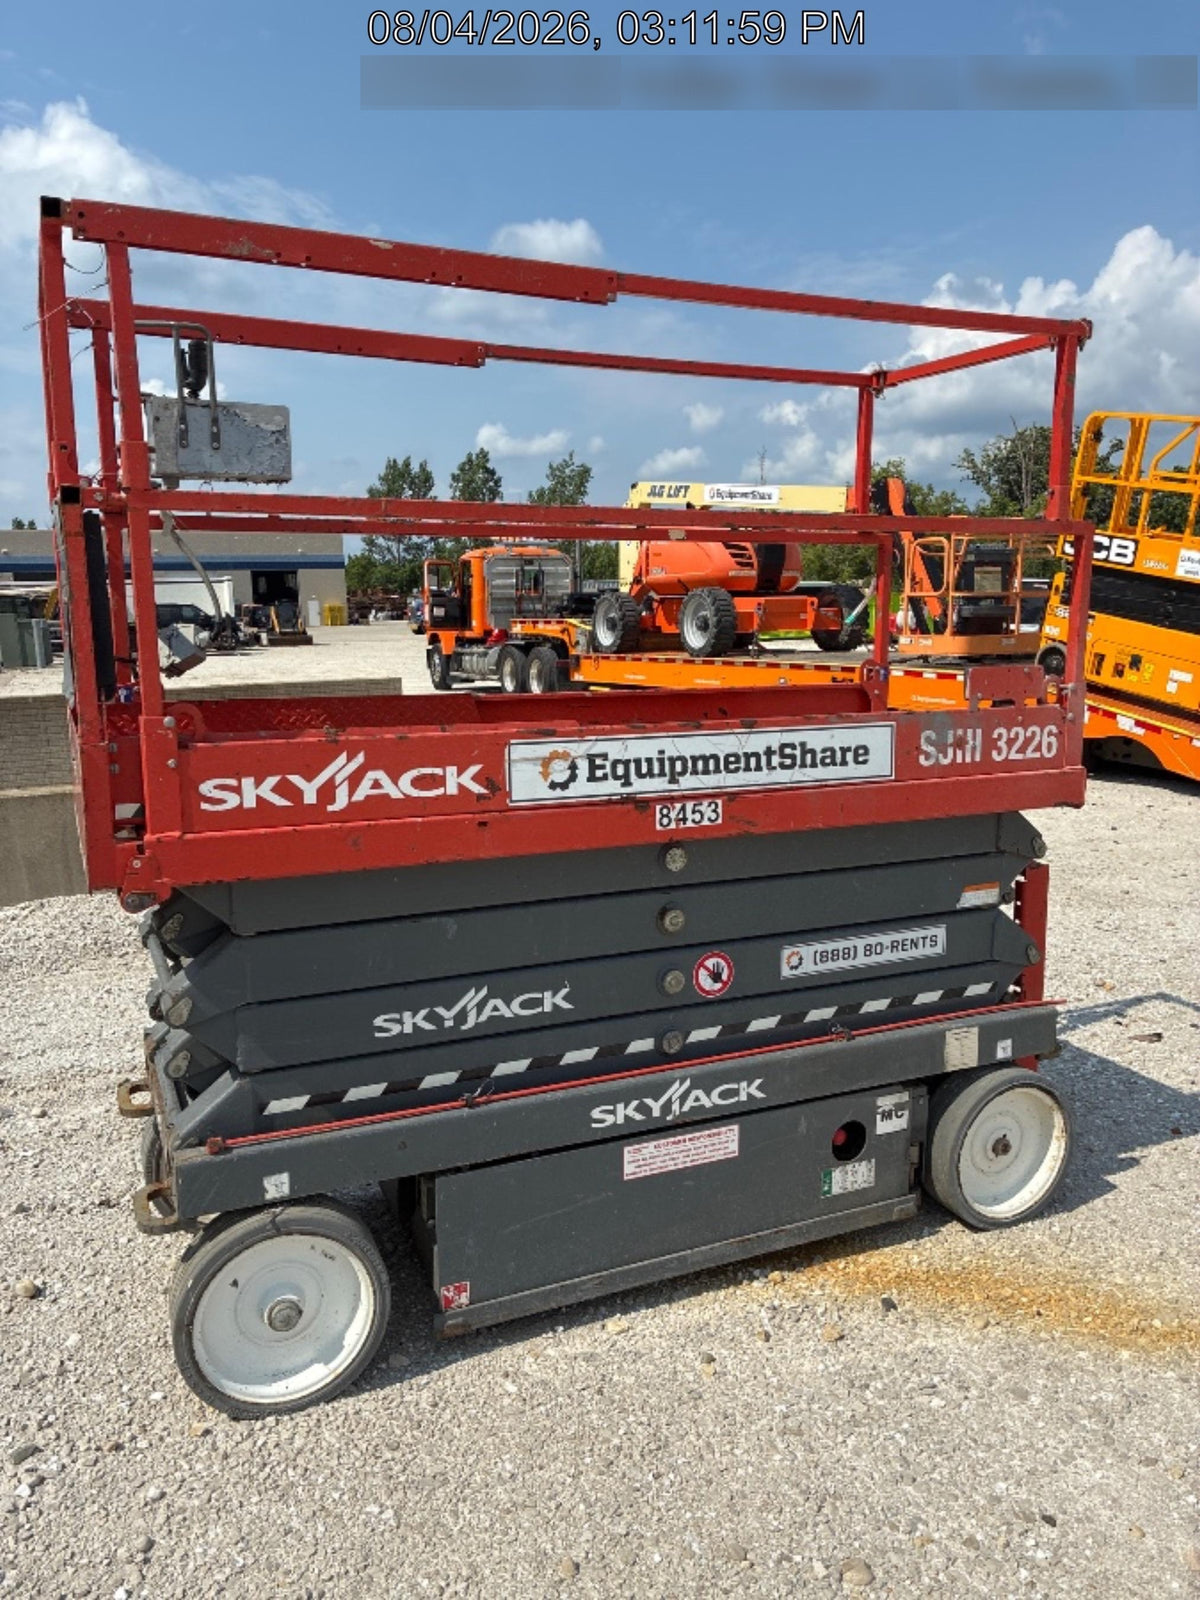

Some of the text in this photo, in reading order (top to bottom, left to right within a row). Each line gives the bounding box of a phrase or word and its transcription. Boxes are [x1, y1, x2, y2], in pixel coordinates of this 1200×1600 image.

[586, 742, 870, 786] EquipmentShare
[992, 725, 1058, 762] 3226
[198, 750, 487, 812] SKYJACK
[658, 802, 720, 828] 8453
[813, 943, 858, 967] (888)
[373, 983, 575, 1037] SKYJACK
[590, 1077, 767, 1128] SKYJACK
